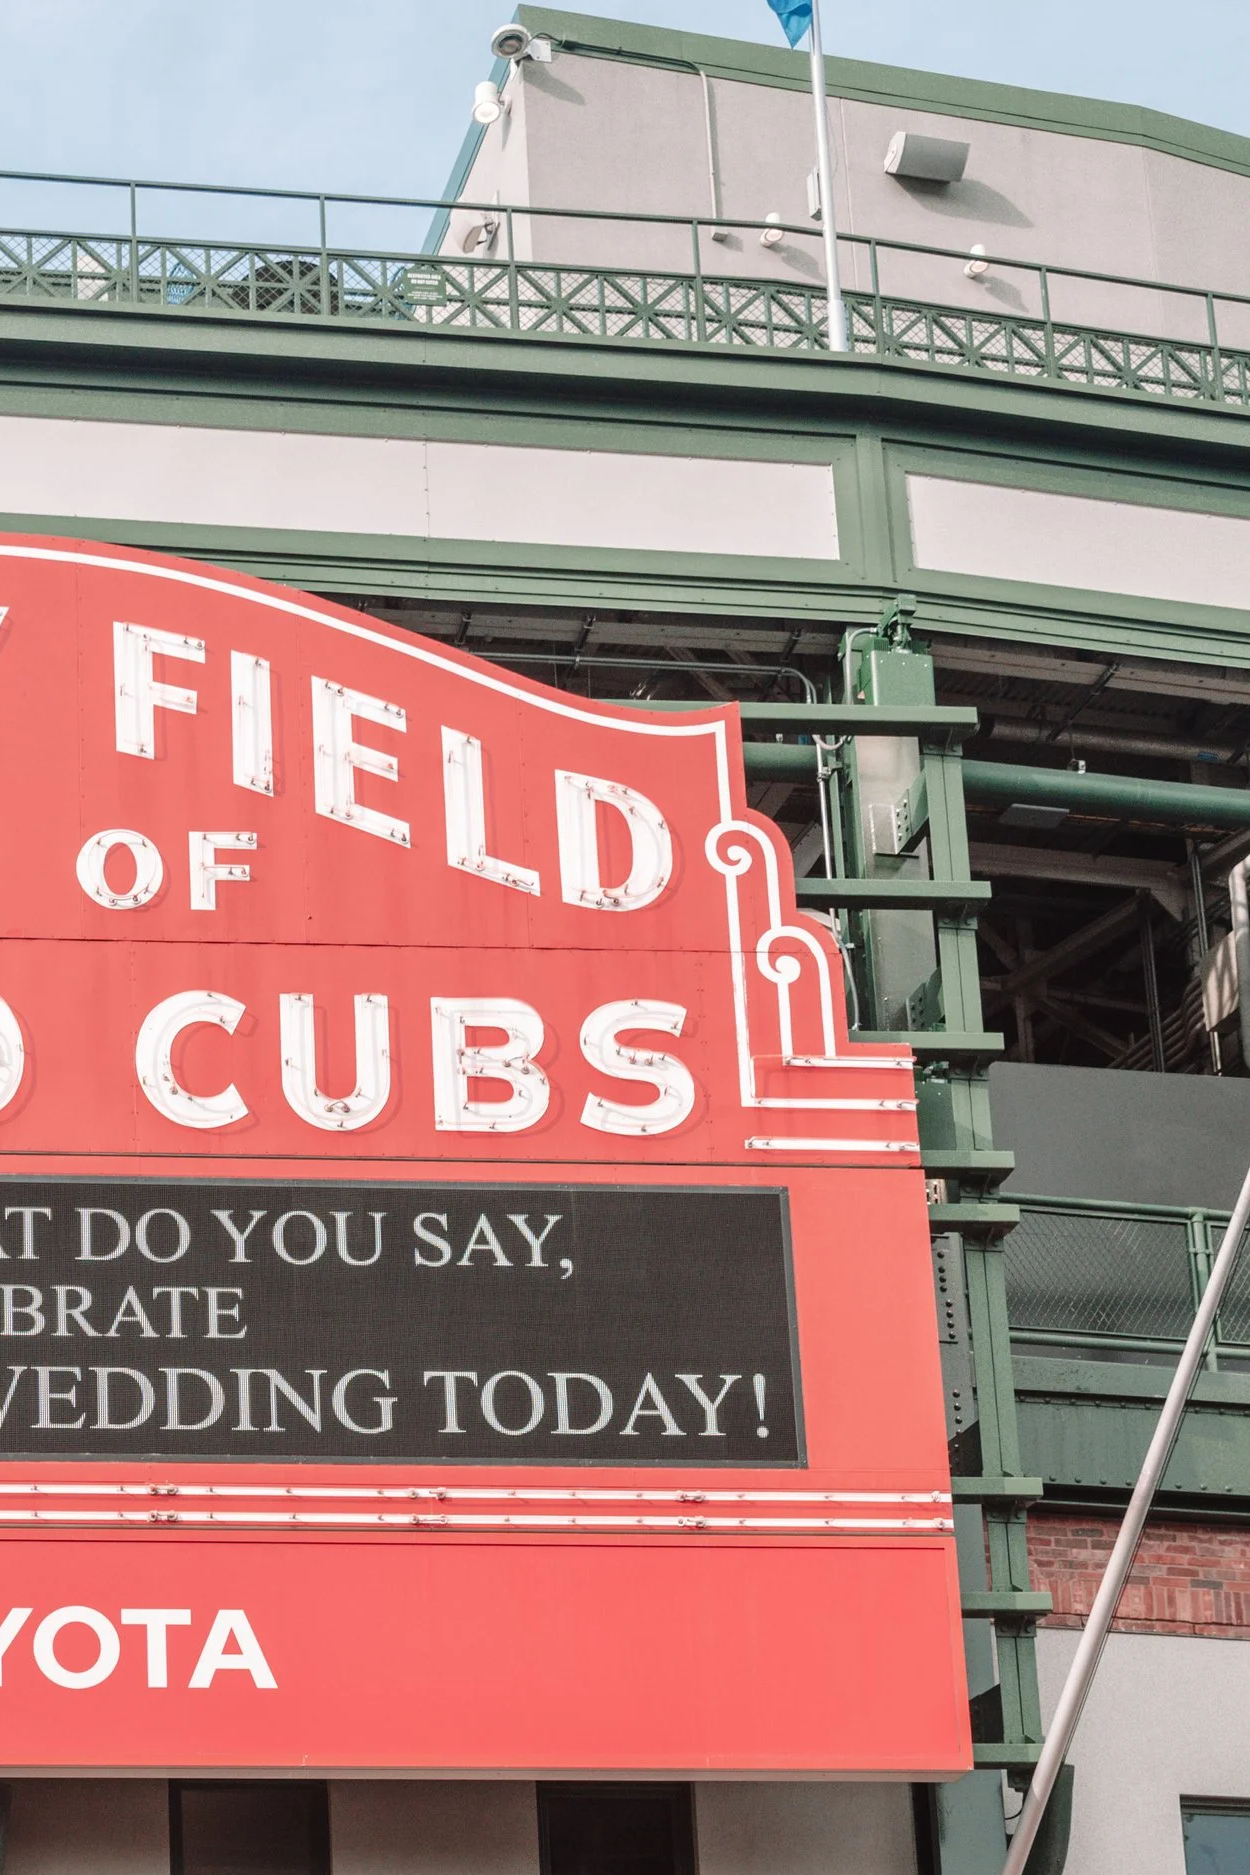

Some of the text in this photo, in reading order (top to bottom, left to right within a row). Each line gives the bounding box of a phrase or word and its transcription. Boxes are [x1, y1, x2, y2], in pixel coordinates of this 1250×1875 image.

[112, 620, 674, 912] FIELD
[76, 828, 258, 911] OF
[136, 990, 696, 1136] CUBS
[74, 1207, 192, 1264] DO
[209, 1209, 387, 1266] YOU
[413, 1212, 574, 1279] SAY,
[423, 1370, 770, 1439] TODAY!
